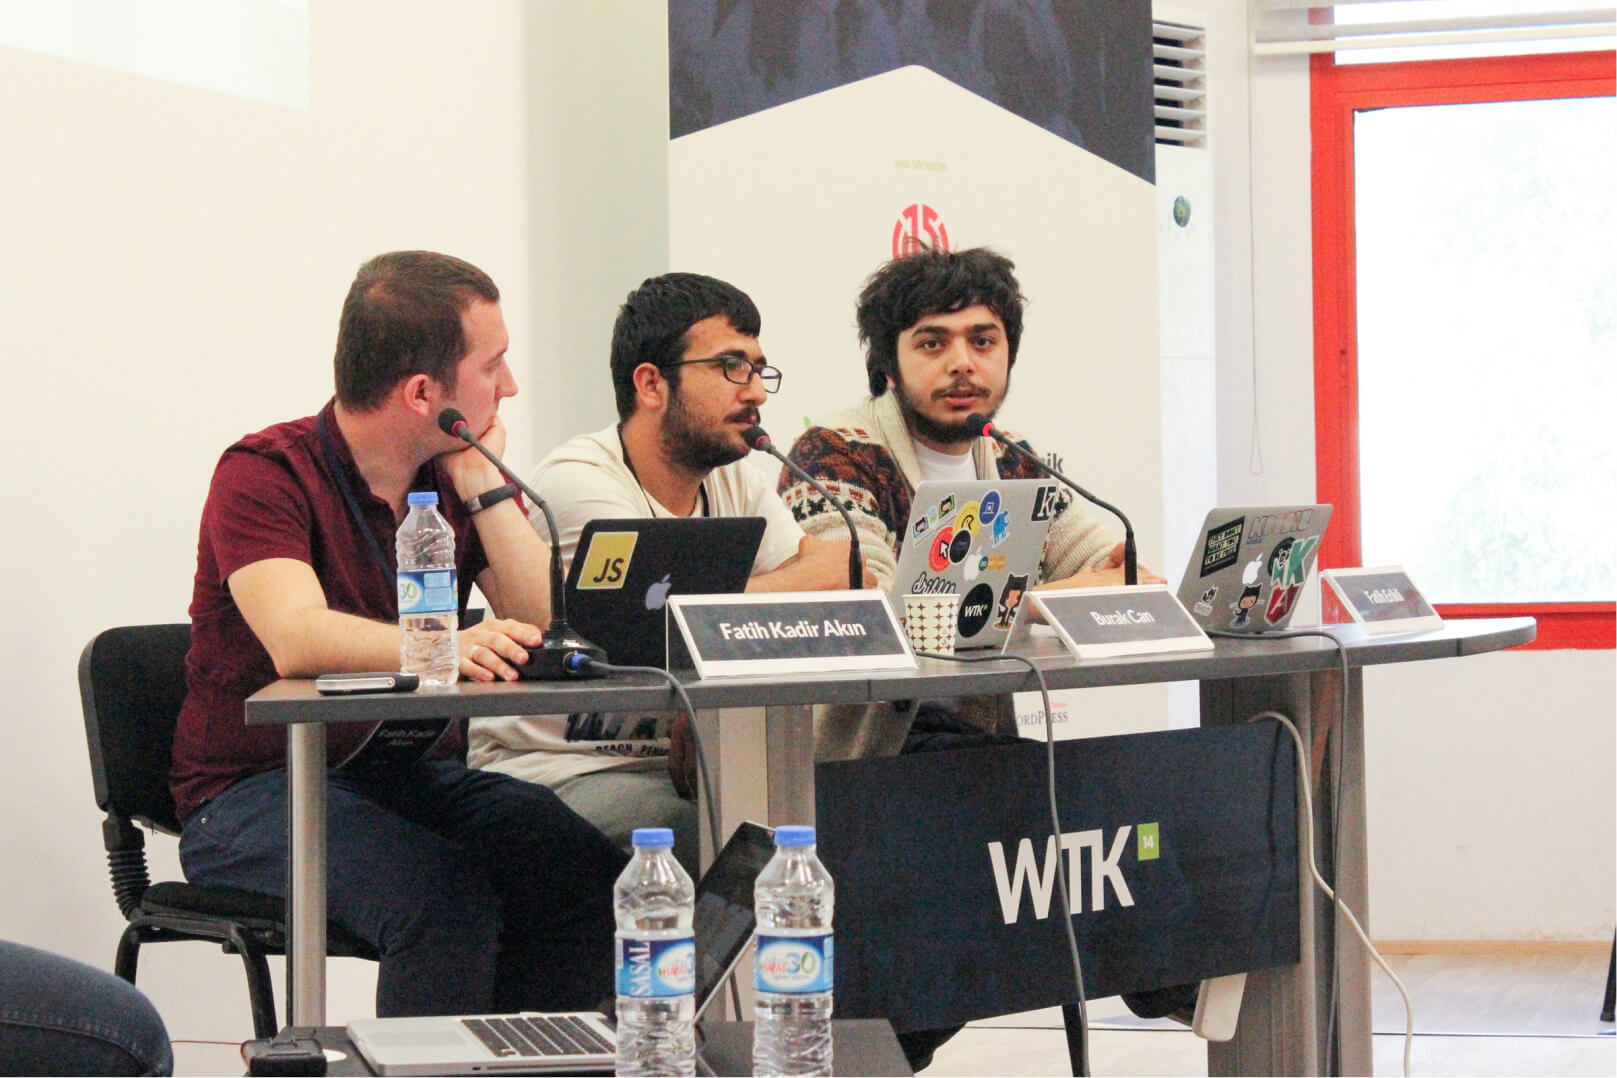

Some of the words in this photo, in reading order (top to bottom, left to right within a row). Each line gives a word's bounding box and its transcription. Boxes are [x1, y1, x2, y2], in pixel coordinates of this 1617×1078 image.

[593, 557, 625, 583] JS
[964, 604, 984, 617] WTK
[1090, 610, 1129, 627] Burak
[1127, 609, 1155, 624] Can
[719, 621, 770, 641] Fatih
[771, 619, 819, 639] Kadir
[987, 825, 1136, 925] WTK
[1142, 834, 1154, 850] 14
